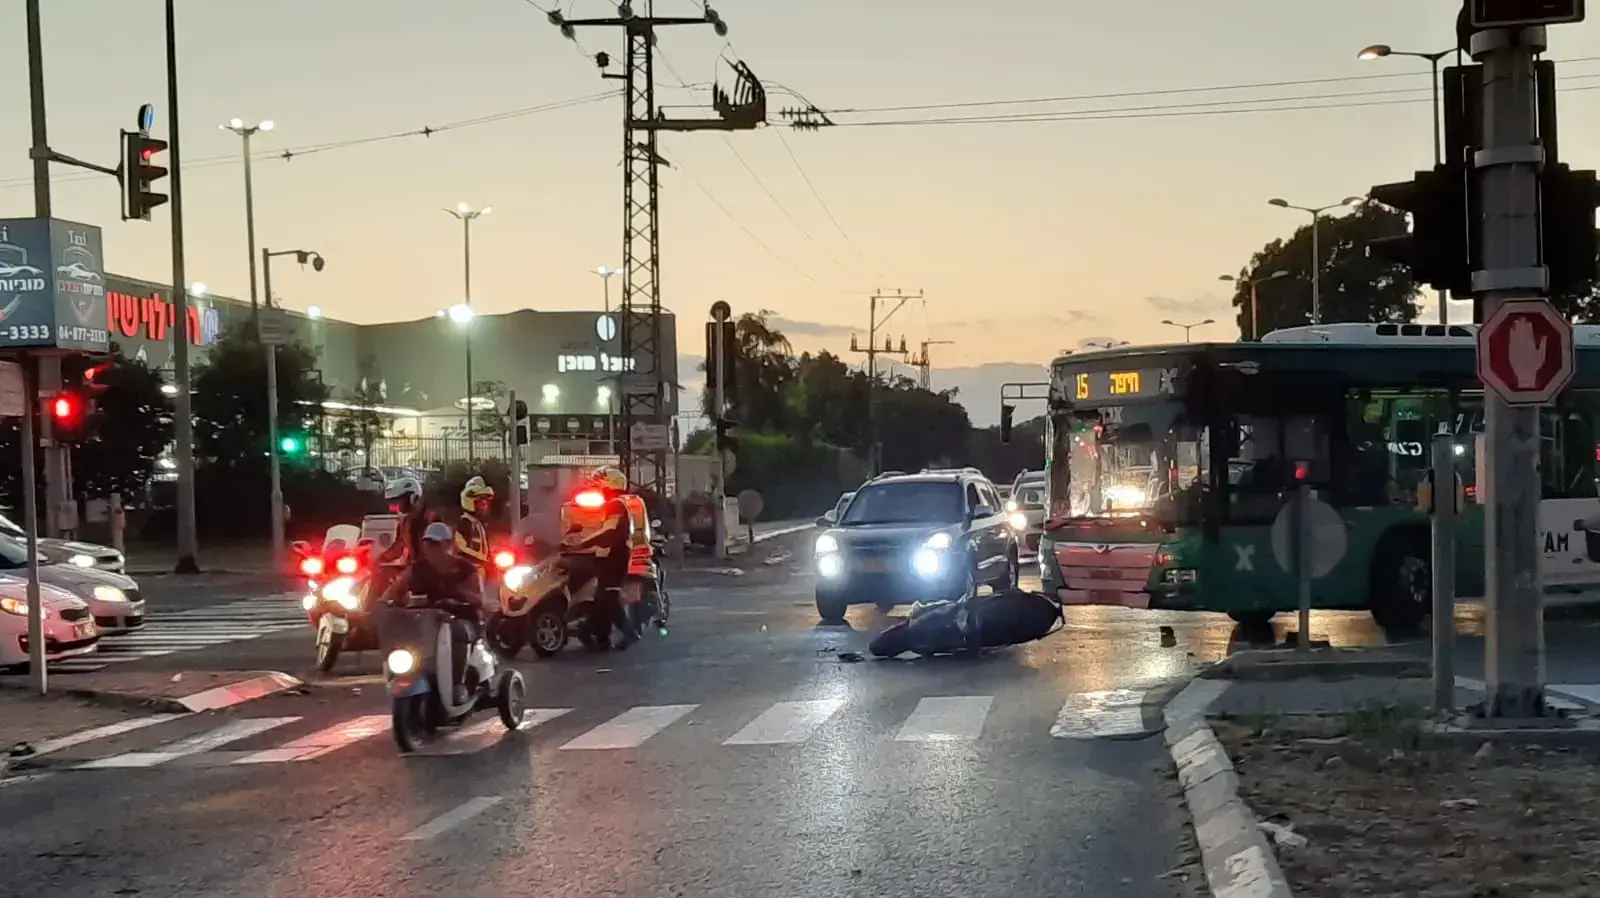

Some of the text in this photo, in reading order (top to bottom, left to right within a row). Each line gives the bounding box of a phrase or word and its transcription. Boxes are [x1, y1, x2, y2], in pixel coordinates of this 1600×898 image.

[68, 230, 88, 245] Taxi
[141, 292, 166, 340] לוי
[557, 354, 597, 373] מוכן
[1076, 372, 1089, 400] 15
[1109, 371, 1140, 395] חיפה
